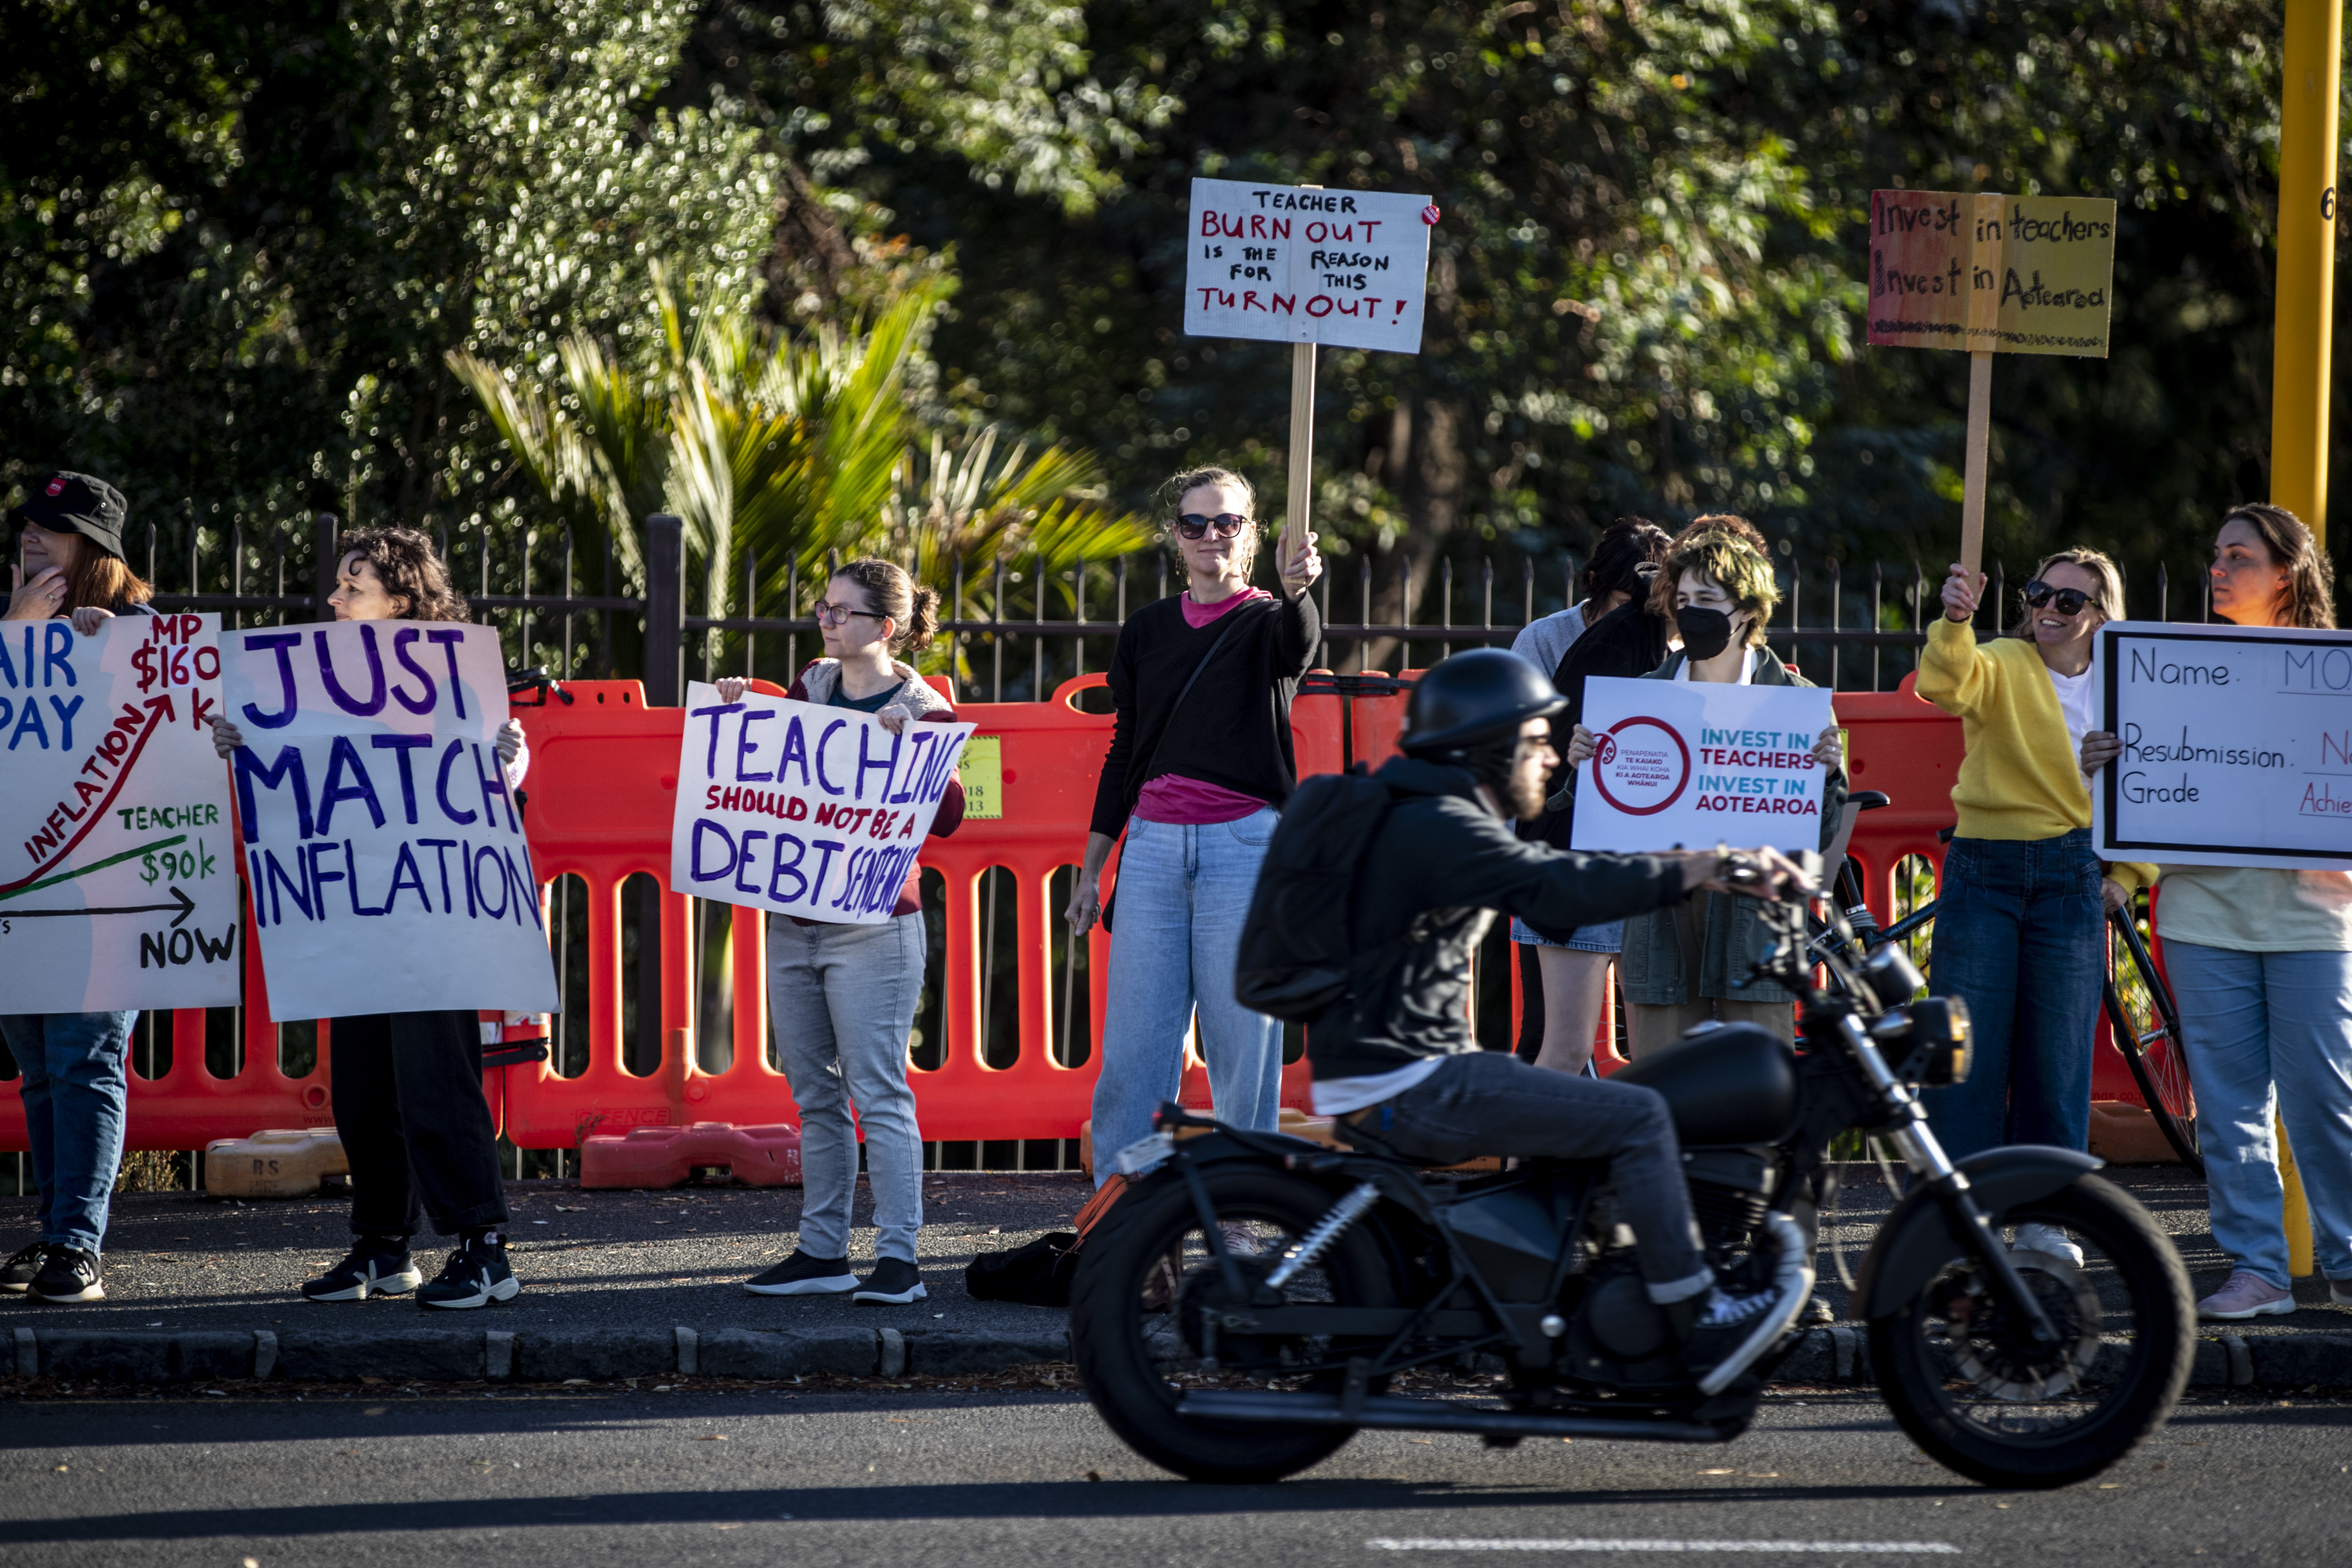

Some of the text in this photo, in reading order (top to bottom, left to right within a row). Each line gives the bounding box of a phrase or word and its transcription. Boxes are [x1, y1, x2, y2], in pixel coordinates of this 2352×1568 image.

[1252, 190, 1357, 214] TEACHER
[1877, 197, 2110, 242] Invest in teachers
[1201, 210, 1382, 243] BURN OUT
[1205, 244, 1389, 271] IS THE REASON
[1230, 263, 1367, 290] FOR THIS
[1874, 248, 1961, 298] Invest
[1973, 265, 1995, 290] in
[151, 614, 202, 646] MP
[131, 638, 220, 694] $160
[242, 623, 464, 729] JUST
[690, 703, 965, 805] TEACHING
[1700, 748, 1816, 770] TEACHERS
[1701, 728, 1810, 750] INVEST IN
[24, 703, 146, 864] INFLATION
[234, 733, 519, 844] MATCH
[1695, 795, 1819, 816] AOTEAROA
[1698, 775, 1806, 796] INVEST IN
[2122, 771, 2200, 804] Grade
[116, 803, 219, 830] TEACHER
[704, 785, 915, 841] SHOULD NOT BE A
[139, 837, 215, 886] $90k
[690, 818, 845, 906] DEBT
[250, 838, 542, 931] INFLATION
[140, 923, 236, 968] NOW
